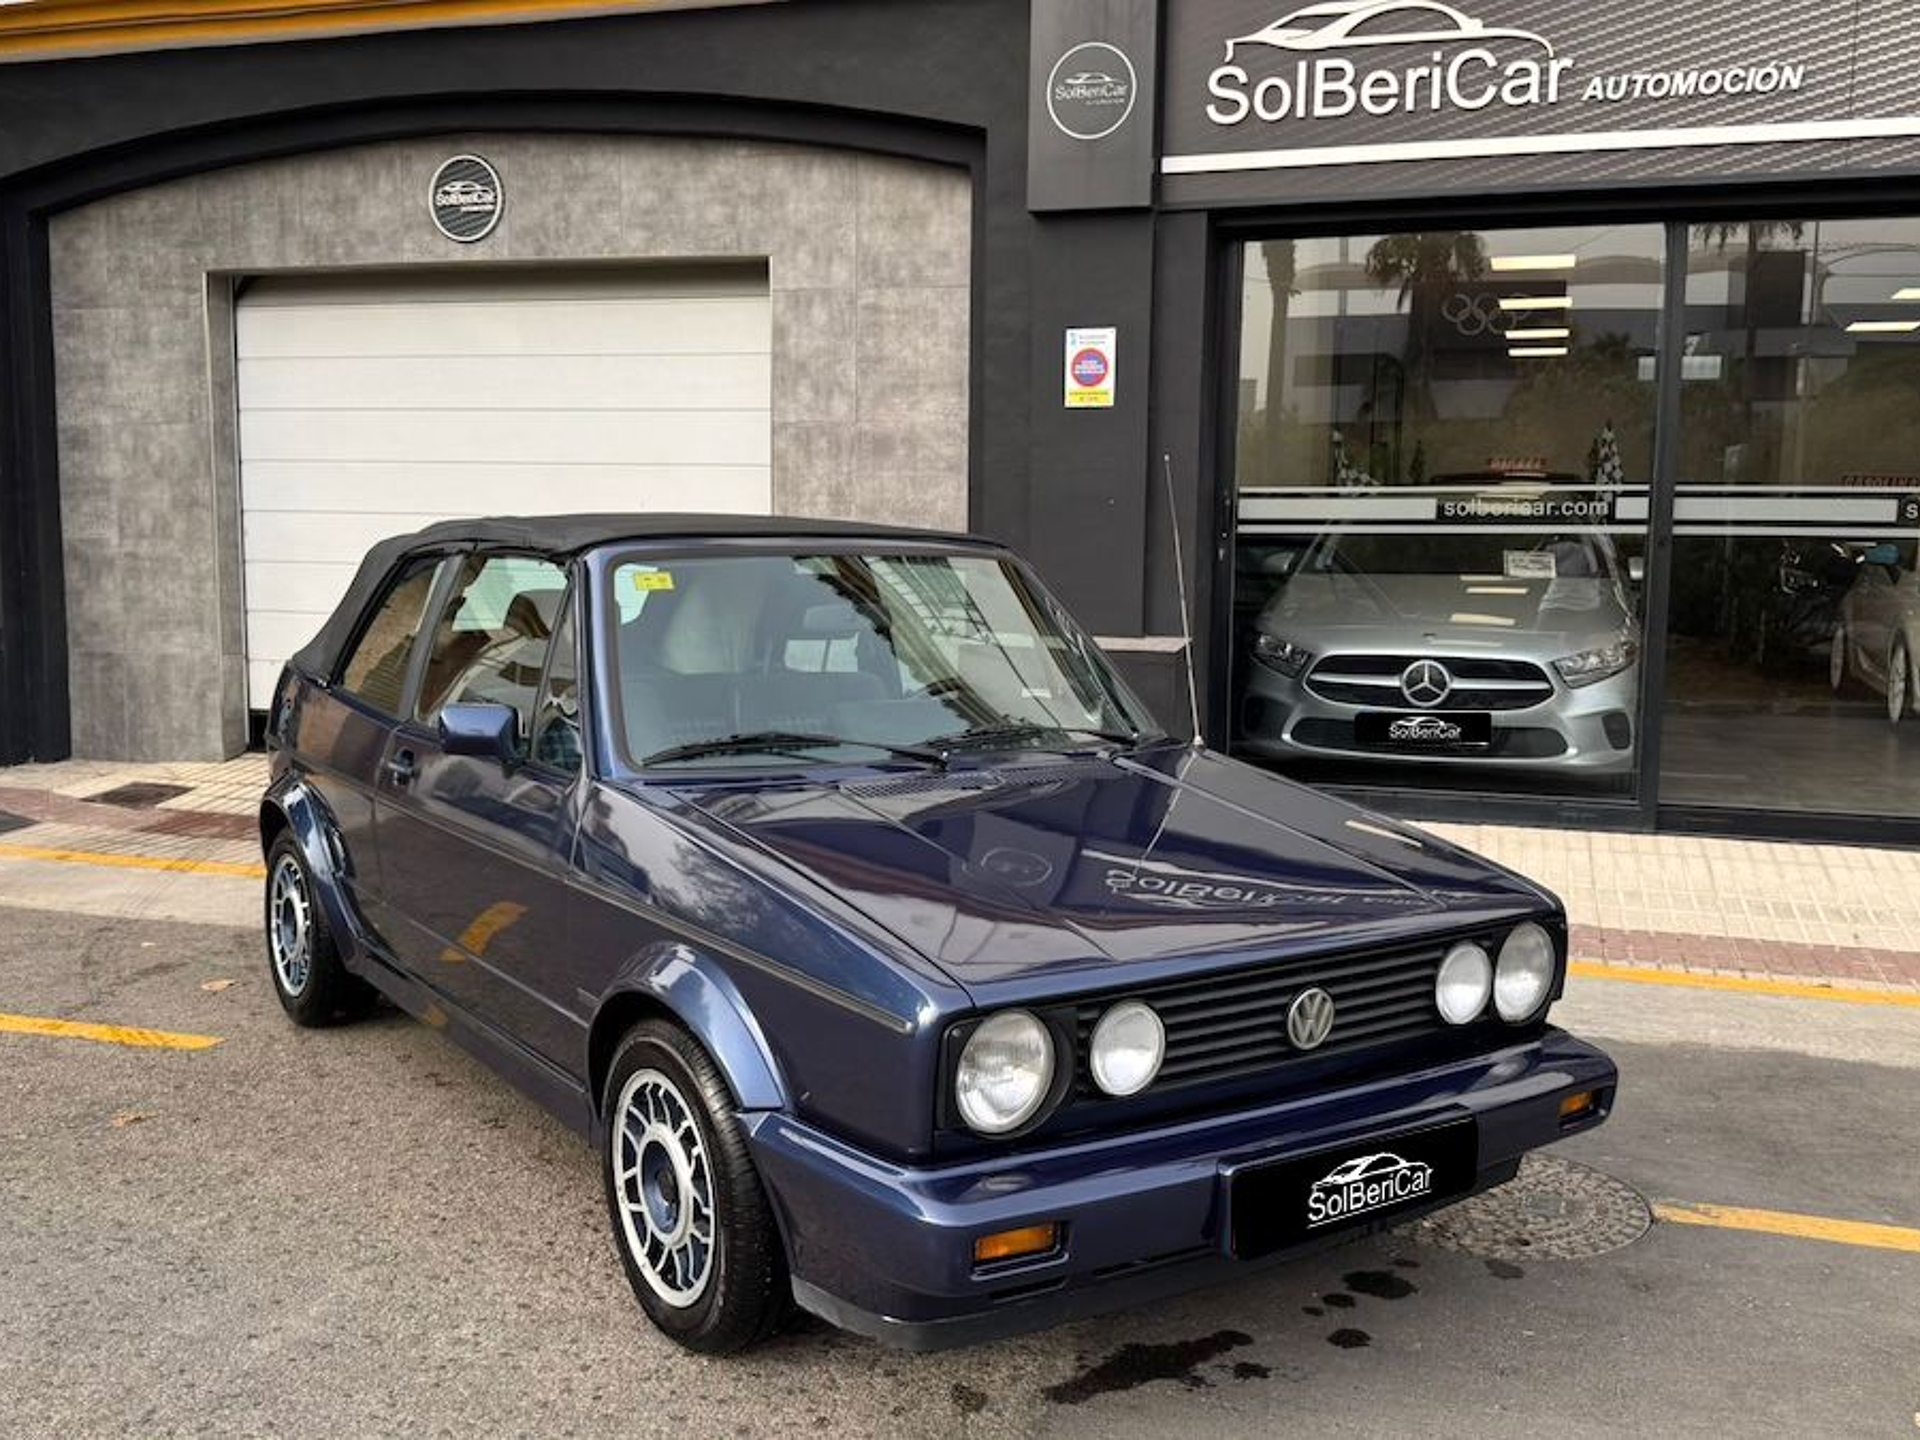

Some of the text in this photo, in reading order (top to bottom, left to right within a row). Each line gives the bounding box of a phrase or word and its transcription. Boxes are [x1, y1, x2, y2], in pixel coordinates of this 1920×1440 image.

[1206, 48, 1805, 125] SolBeriCar AUTOMOCIÓN
[1443, 498, 1610, 517] solbericar.com
[1307, 1168, 1433, 1221] SolBeriCar
